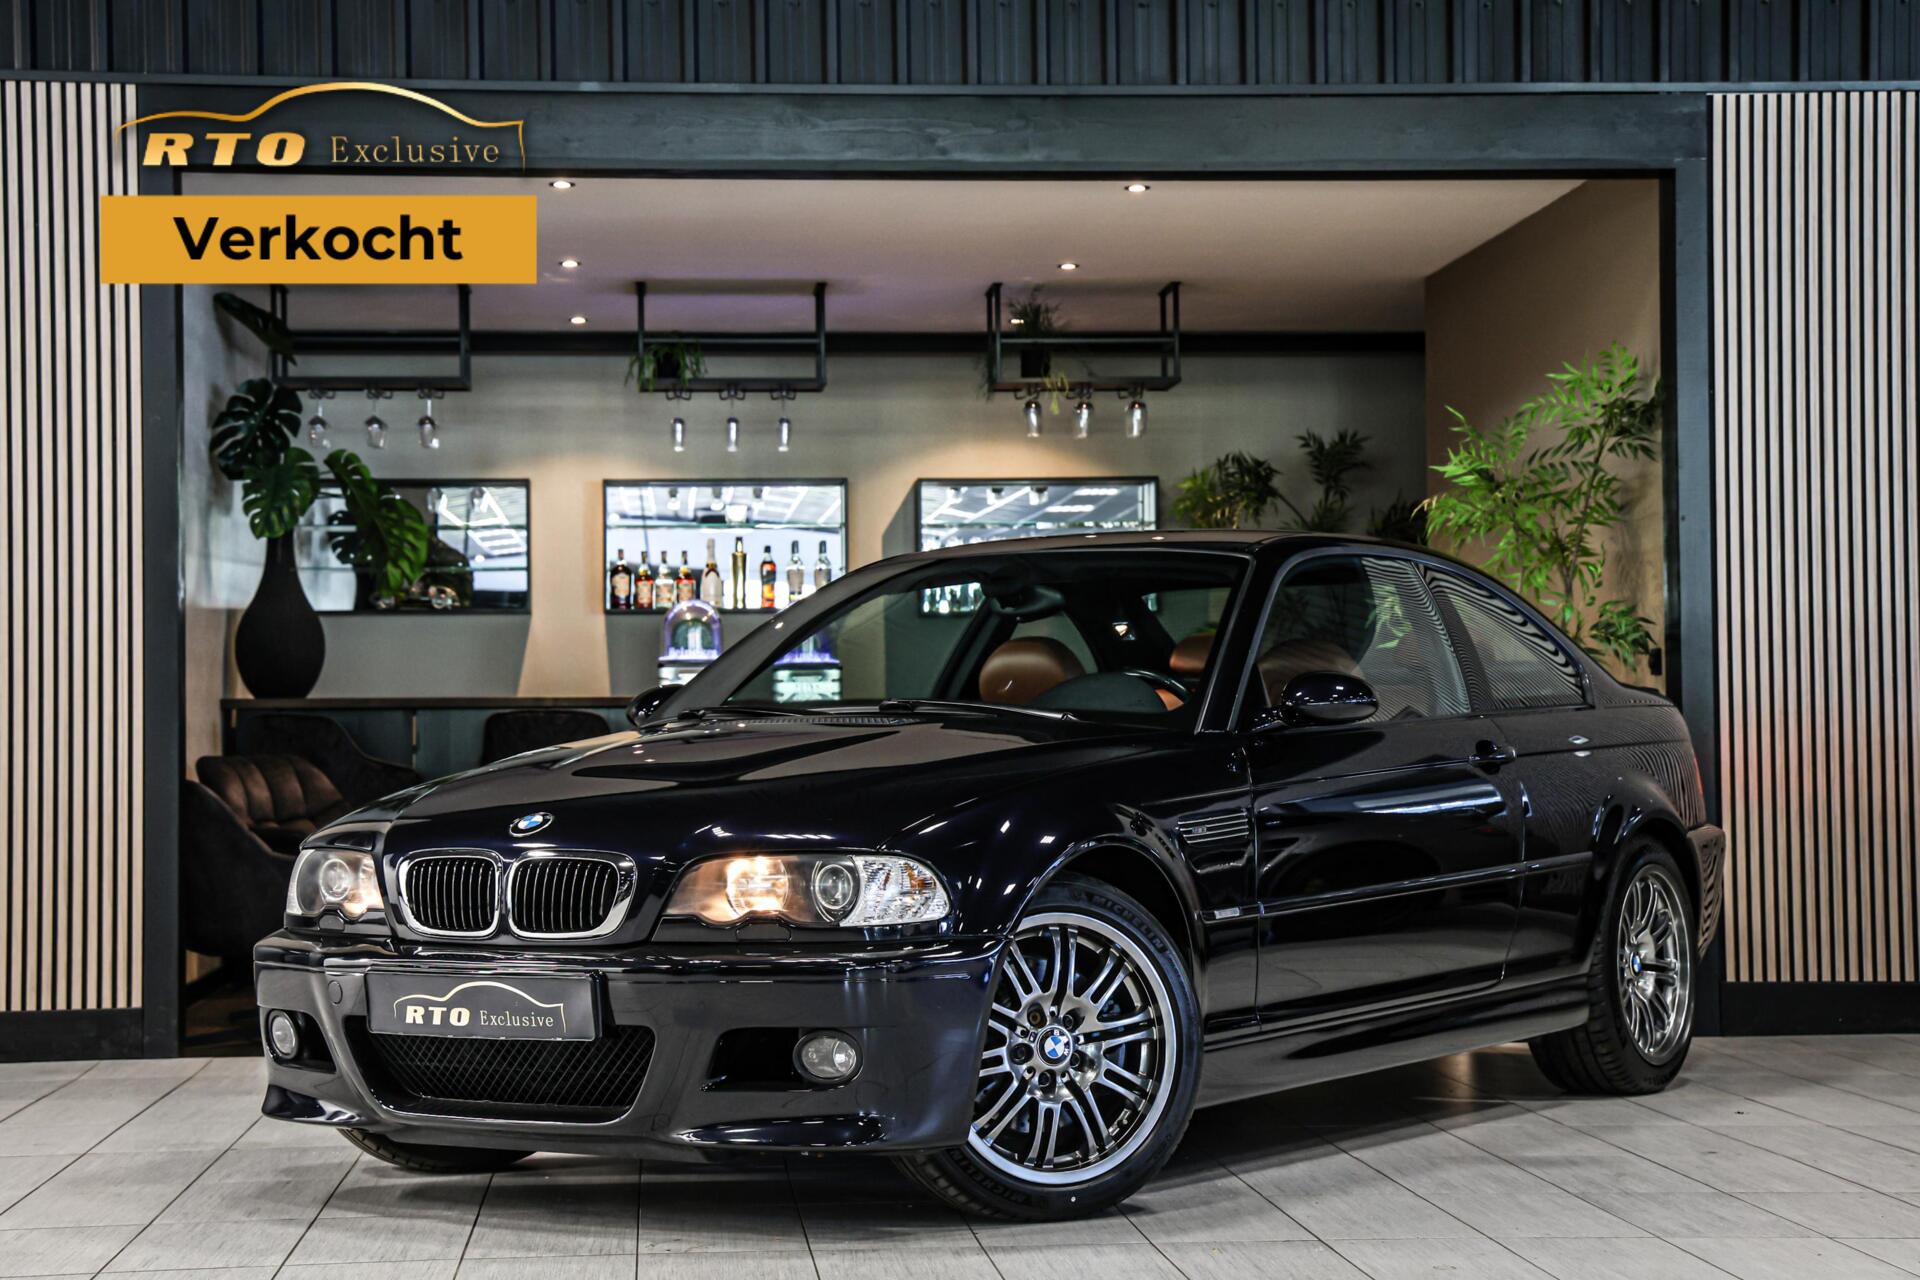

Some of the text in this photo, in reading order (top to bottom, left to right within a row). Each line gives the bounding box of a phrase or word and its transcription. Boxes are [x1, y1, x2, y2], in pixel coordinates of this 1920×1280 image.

[1093, 895, 1164, 948] MICHELIN
[405, 1005, 554, 1027] RTO Exclusive
